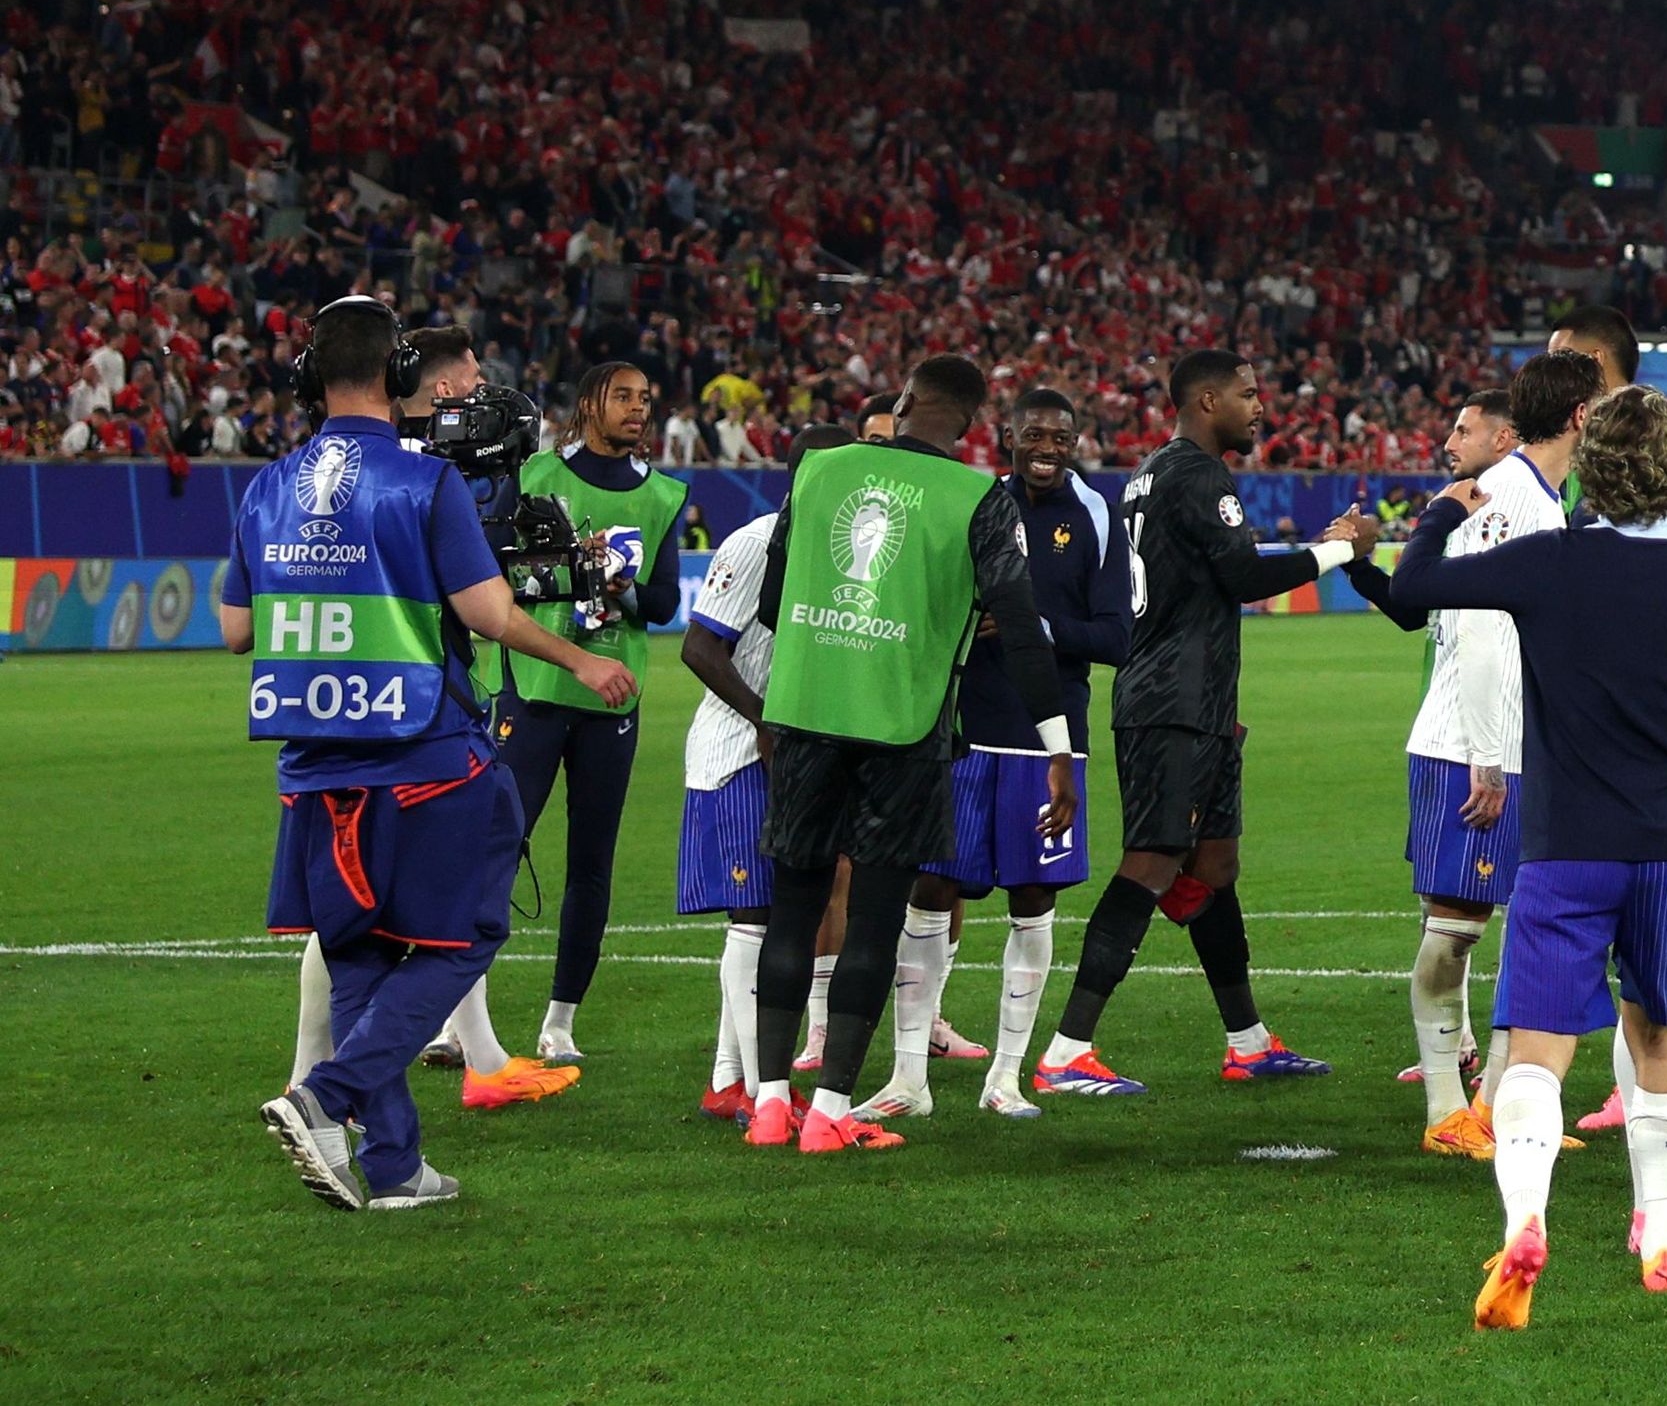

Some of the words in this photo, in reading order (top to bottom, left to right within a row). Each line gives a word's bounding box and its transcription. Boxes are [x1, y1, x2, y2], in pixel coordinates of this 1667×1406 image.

[475, 443, 504, 459] RONIN
[863, 473, 925, 512] SAMBA
[301, 522, 341, 540] UEFA
[286, 565, 349, 577] GERMANY
[833, 587, 876, 610] UEFA
[270, 601, 354, 654] HB
[815, 631, 877, 653] GERMANY
